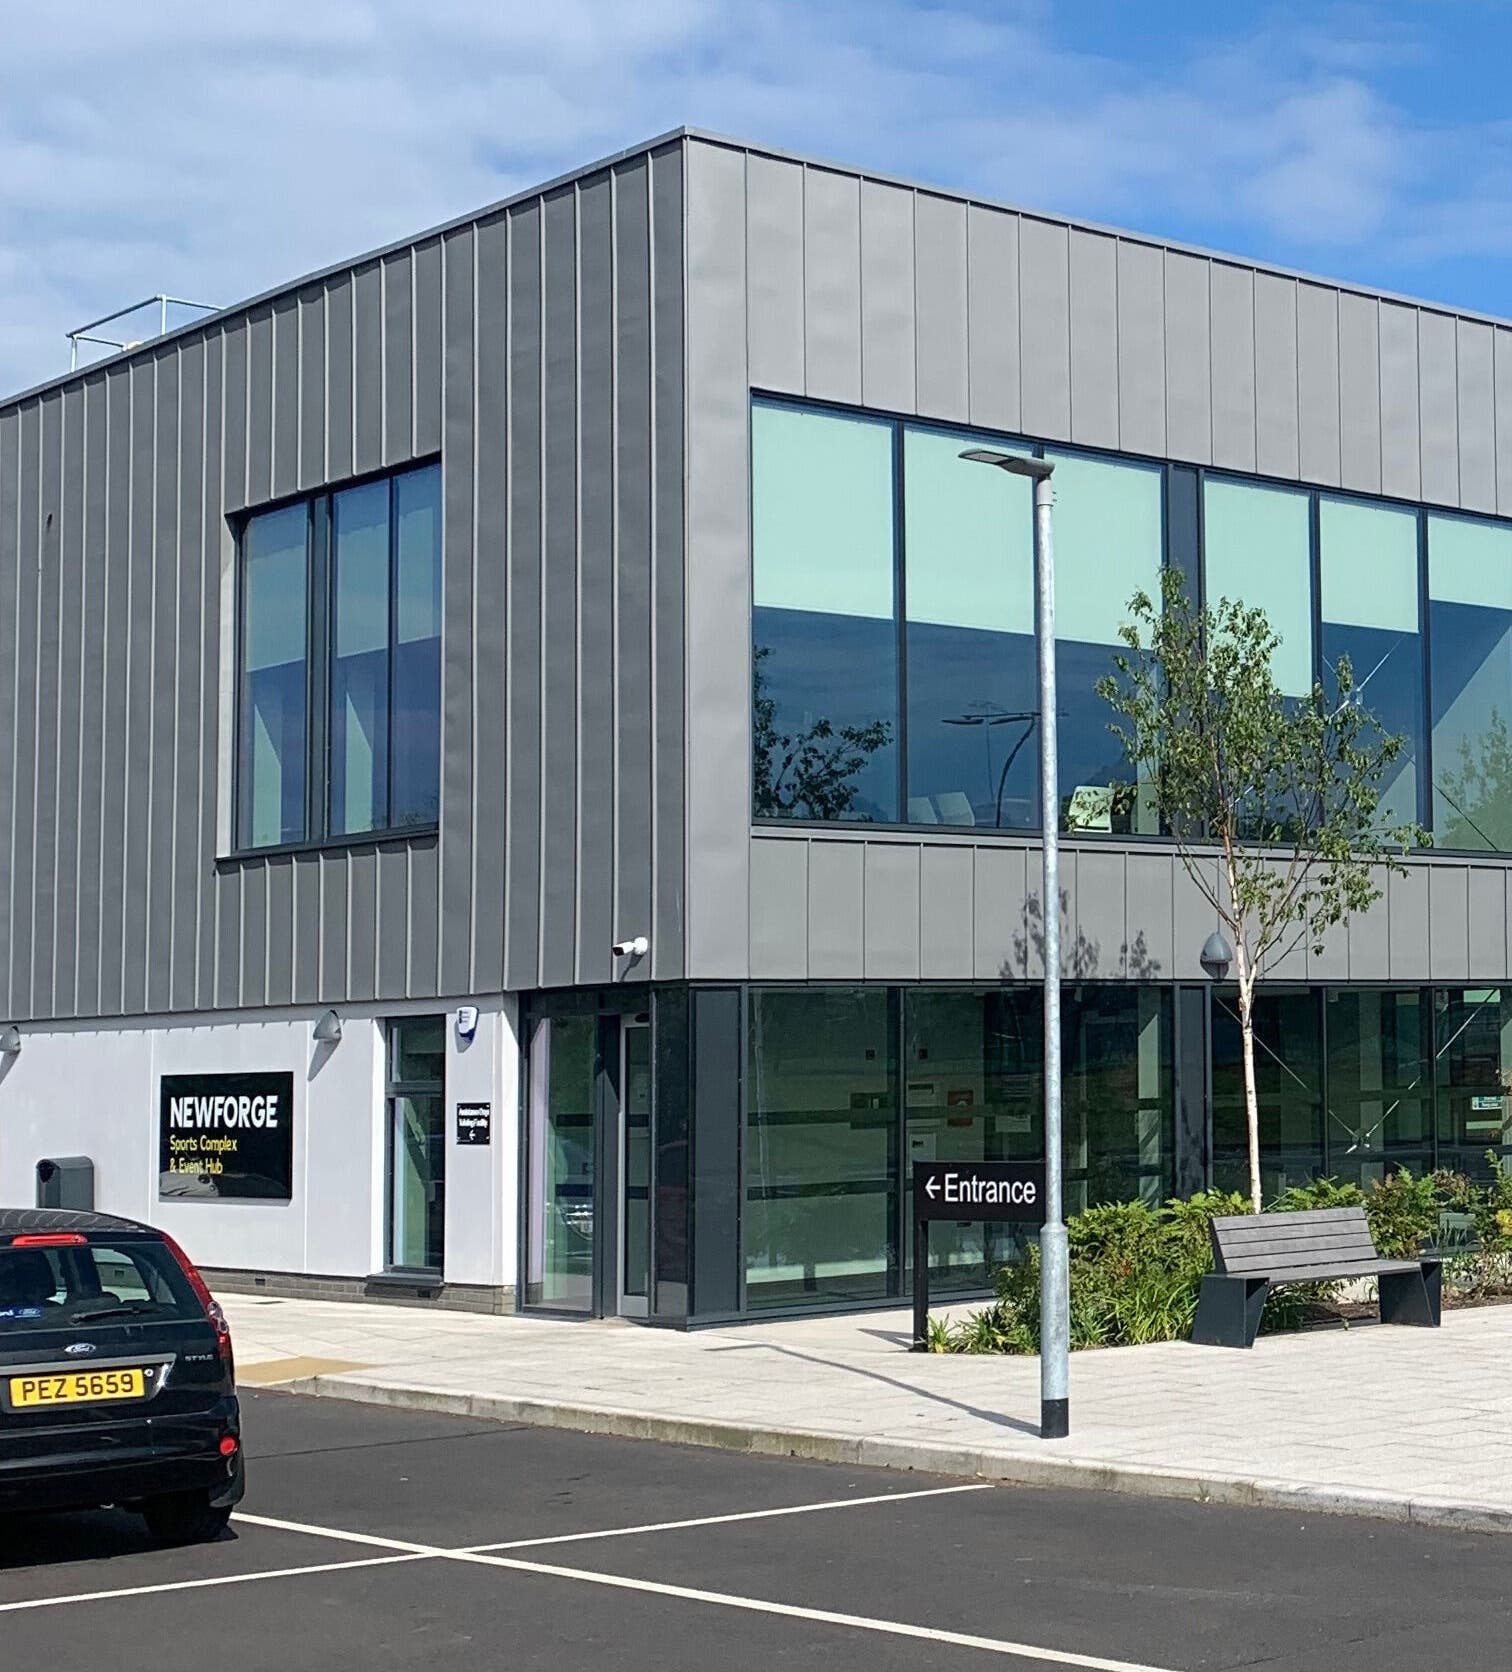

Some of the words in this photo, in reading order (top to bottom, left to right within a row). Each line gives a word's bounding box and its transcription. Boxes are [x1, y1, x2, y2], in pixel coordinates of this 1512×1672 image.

[170, 1095, 278, 1128] NEWFORGE
[170, 1134, 198, 1154] Sports
[200, 1134, 238, 1155] Complex
[170, 1158, 177, 1174] &
[179, 1158, 204, 1174] Event
[205, 1158, 223, 1175] Hub
[945, 1173, 1036, 1204] Entrance
[22, 1377, 67, 1401] PEZ
[75, 1373, 134, 1396] 5659
